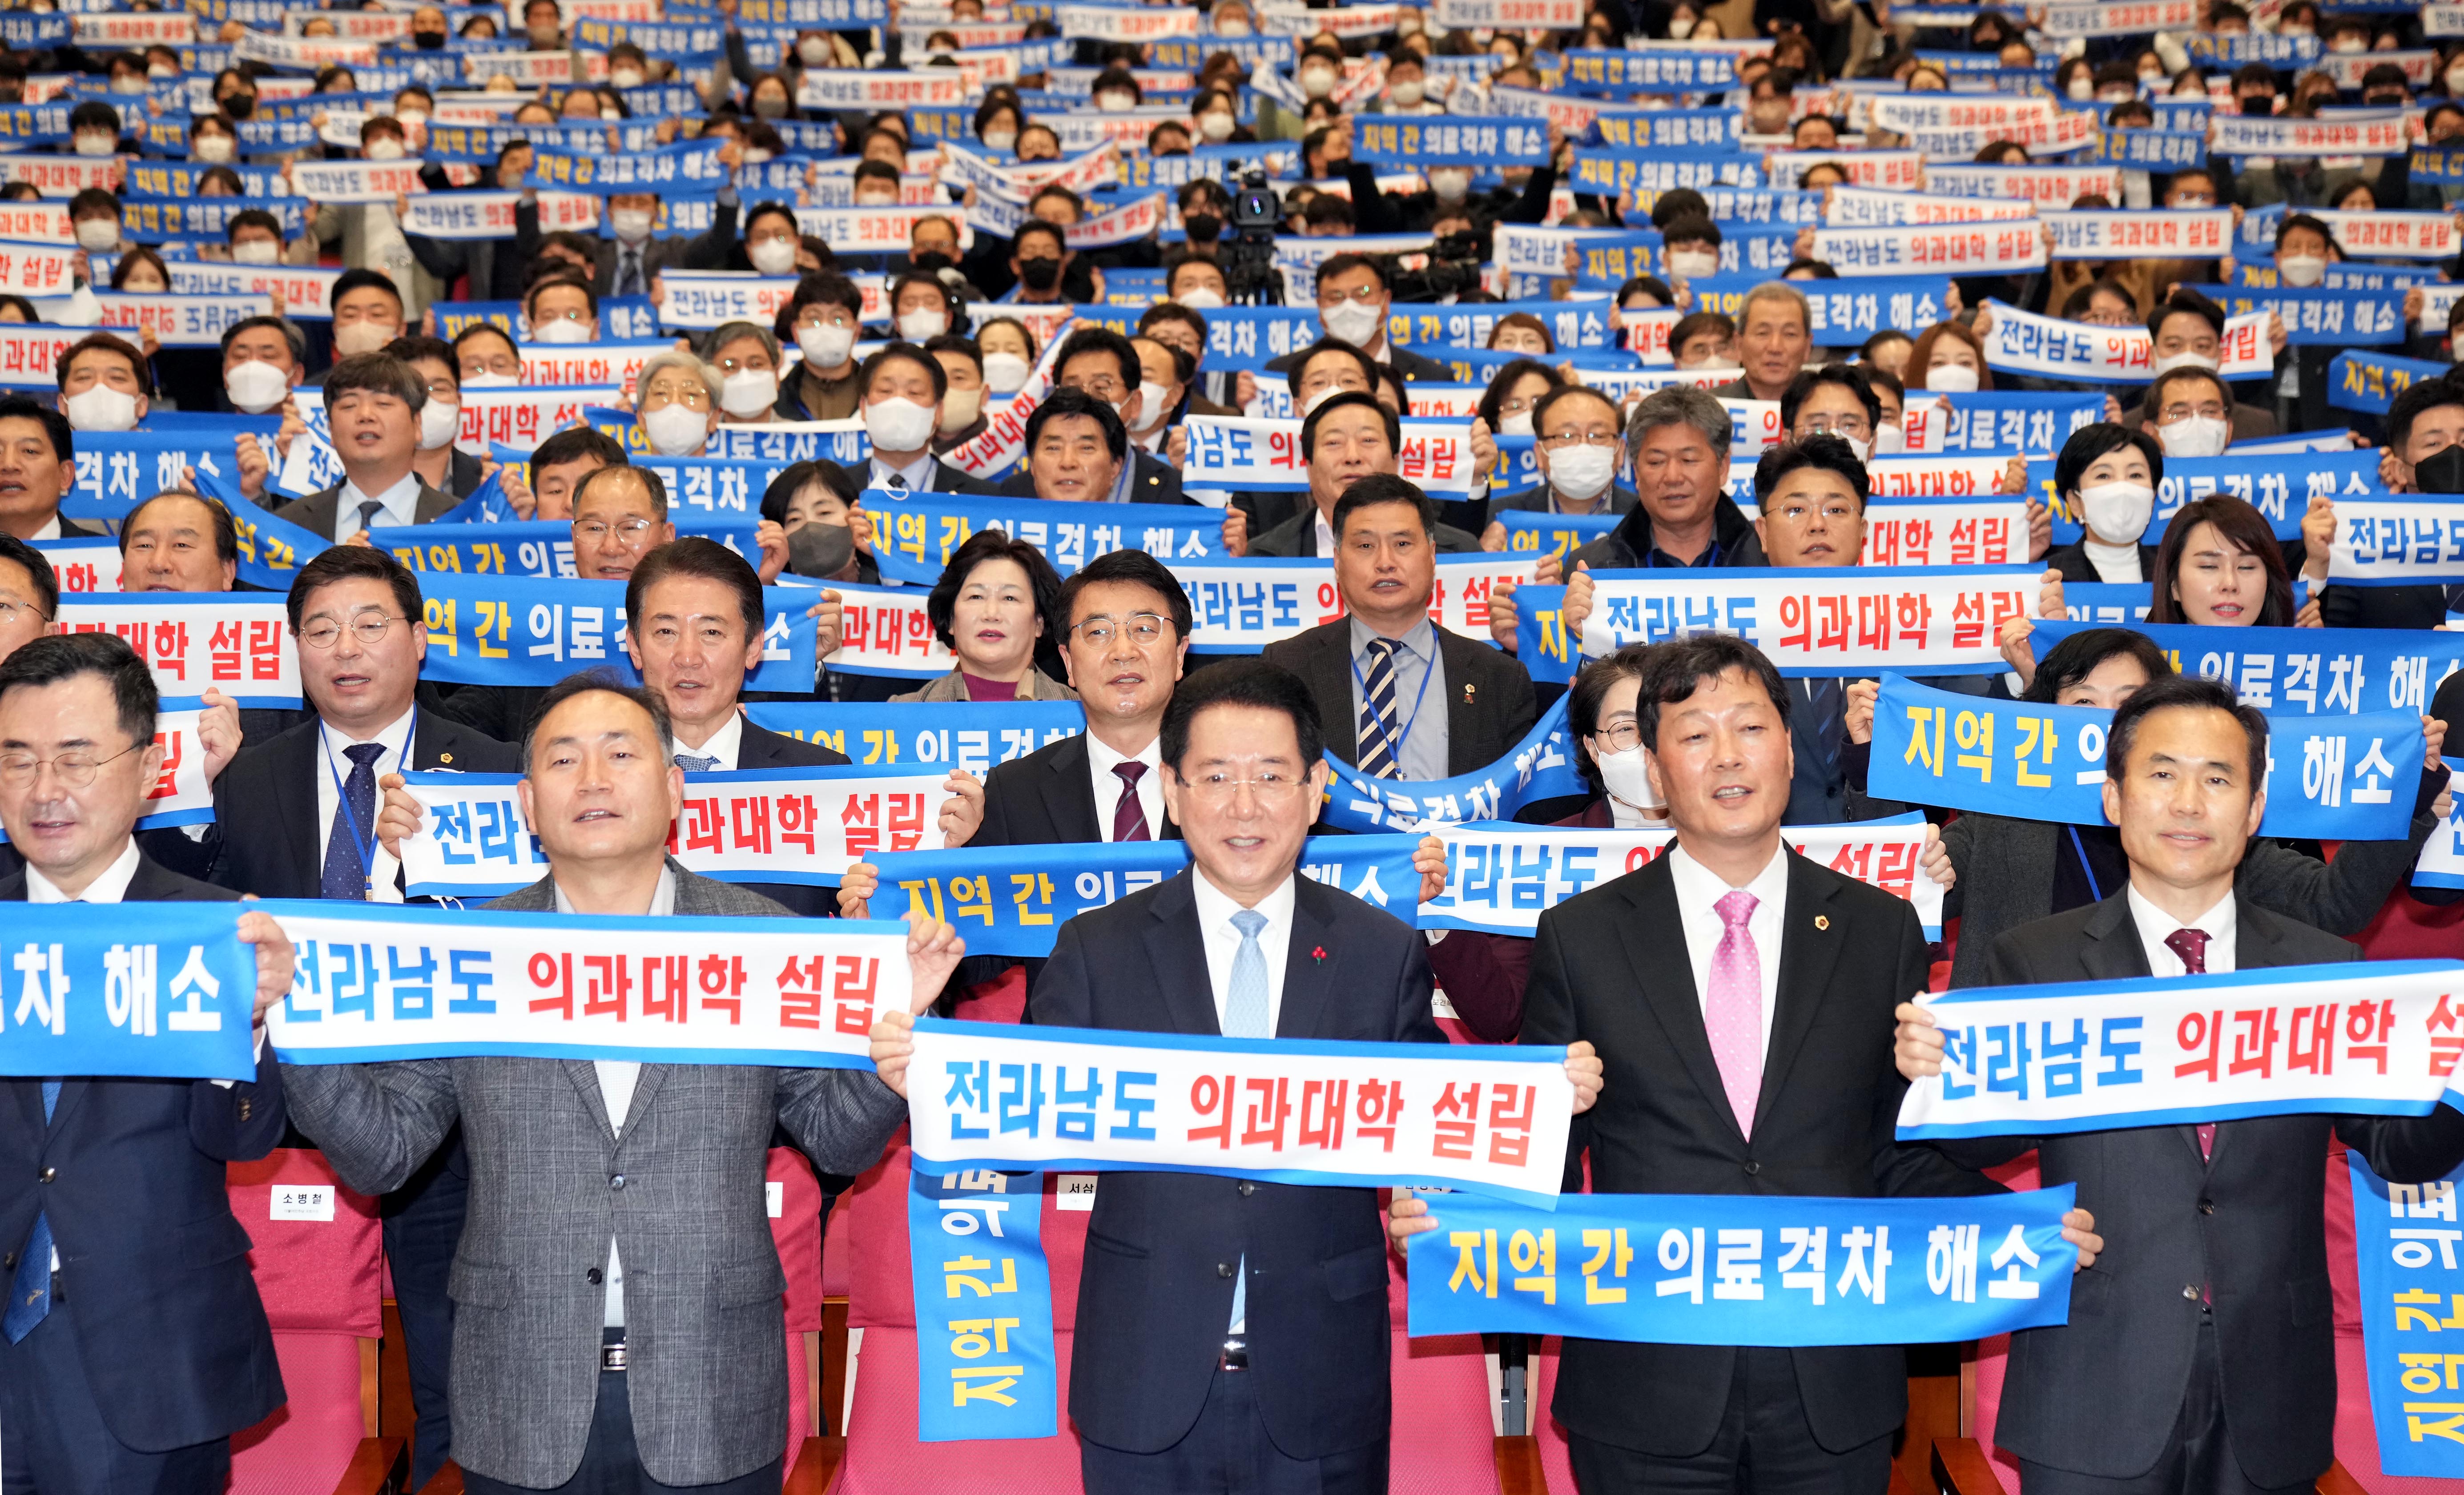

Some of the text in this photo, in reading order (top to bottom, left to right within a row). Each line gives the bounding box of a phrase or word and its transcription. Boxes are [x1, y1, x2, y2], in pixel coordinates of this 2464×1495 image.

[433, 129, 488, 155] 지역 간
[1362, 125, 1542, 156] 지역 간 의료격차 해소
[1635, 120, 1651, 147] 간
[1655, 117, 1723, 147] 의료격차
[18, 165, 82, 190] 의과대학
[135, 169, 190, 197] 지역 간
[535, 156, 572, 183] 지역
[575, 157, 594, 185] 간
[683, 150, 721, 179] 해소
[1580, 159, 1614, 185] 지역
[1619, 160, 1636, 189] 간
[1640, 161, 1714, 189] 의료격차
[1885, 159, 1915, 185] 설립
[1780, 193, 1818, 222] 해소
[2005, 177, 2069, 201] 의과대학
[124, 204, 182, 233] 지역 간
[414, 198, 588, 228] 전라남도 설립
[1824, 230, 2033, 267] 전라남도 의과대학 설립
[2110, 220, 2221, 247] 의과대학 설립
[2346, 221, 2451, 248] 의과대학 설립
[22, 253, 63, 288] 설립
[1588, 237, 1790, 280] 지역 간 해소
[610, 306, 653, 339] 해소
[673, 289, 747, 317] 전라남도
[1890, 293, 1937, 332] 해소
[2263, 298, 2345, 334] 의료격차
[2353, 300, 2396, 334] 해소
[1268, 320, 1314, 353] 해소
[1419, 311, 1603, 348] 간 해소
[2001, 318, 2092, 364] 전라남도
[706, 430, 817, 462] 의료격차
[1944, 409, 2056, 451] 의료격차
[1401, 437, 1456, 479] 설립
[2158, 472, 2289, 521] 의료격차
[471, 544, 505, 574] 간
[866, 510, 1209, 569] 지역 간 의료격차 해소
[1862, 517, 2010, 566] 대학 설립
[475, 601, 512, 659] 간
[527, 604, 627, 661] 의료
[1606, 591, 2025, 653] 전라남도 의과대학 설립
[208, 621, 281, 681] 설립
[2199, 651, 2365, 715] 의료격차
[1904, 705, 2395, 807] 지역 간 해소
[431, 793, 925, 865] 전라 과대학 설립
[1829, 842, 1921, 902] 설립
[898, 872, 1055, 927] 지역 간
[0, 943, 221, 1036] 차 해소
[285, 940, 880, 1037] 전라남도 의과대학 설립
[1938, 1016, 2143, 1101] 전라남도
[2174, 999, 2395, 1082] 의과대학
[944, 1060, 1536, 1168] 전라남도 의과대학 설립
[943, 1255, 1018, 1299] 간
[1448, 1224, 2041, 1306] 지역 간 의료격차 해소
[2393, 1288, 2464, 1333] 간
[950, 1316, 1023, 1407] 지역
[2398, 1353, 2464, 1442] 지역
